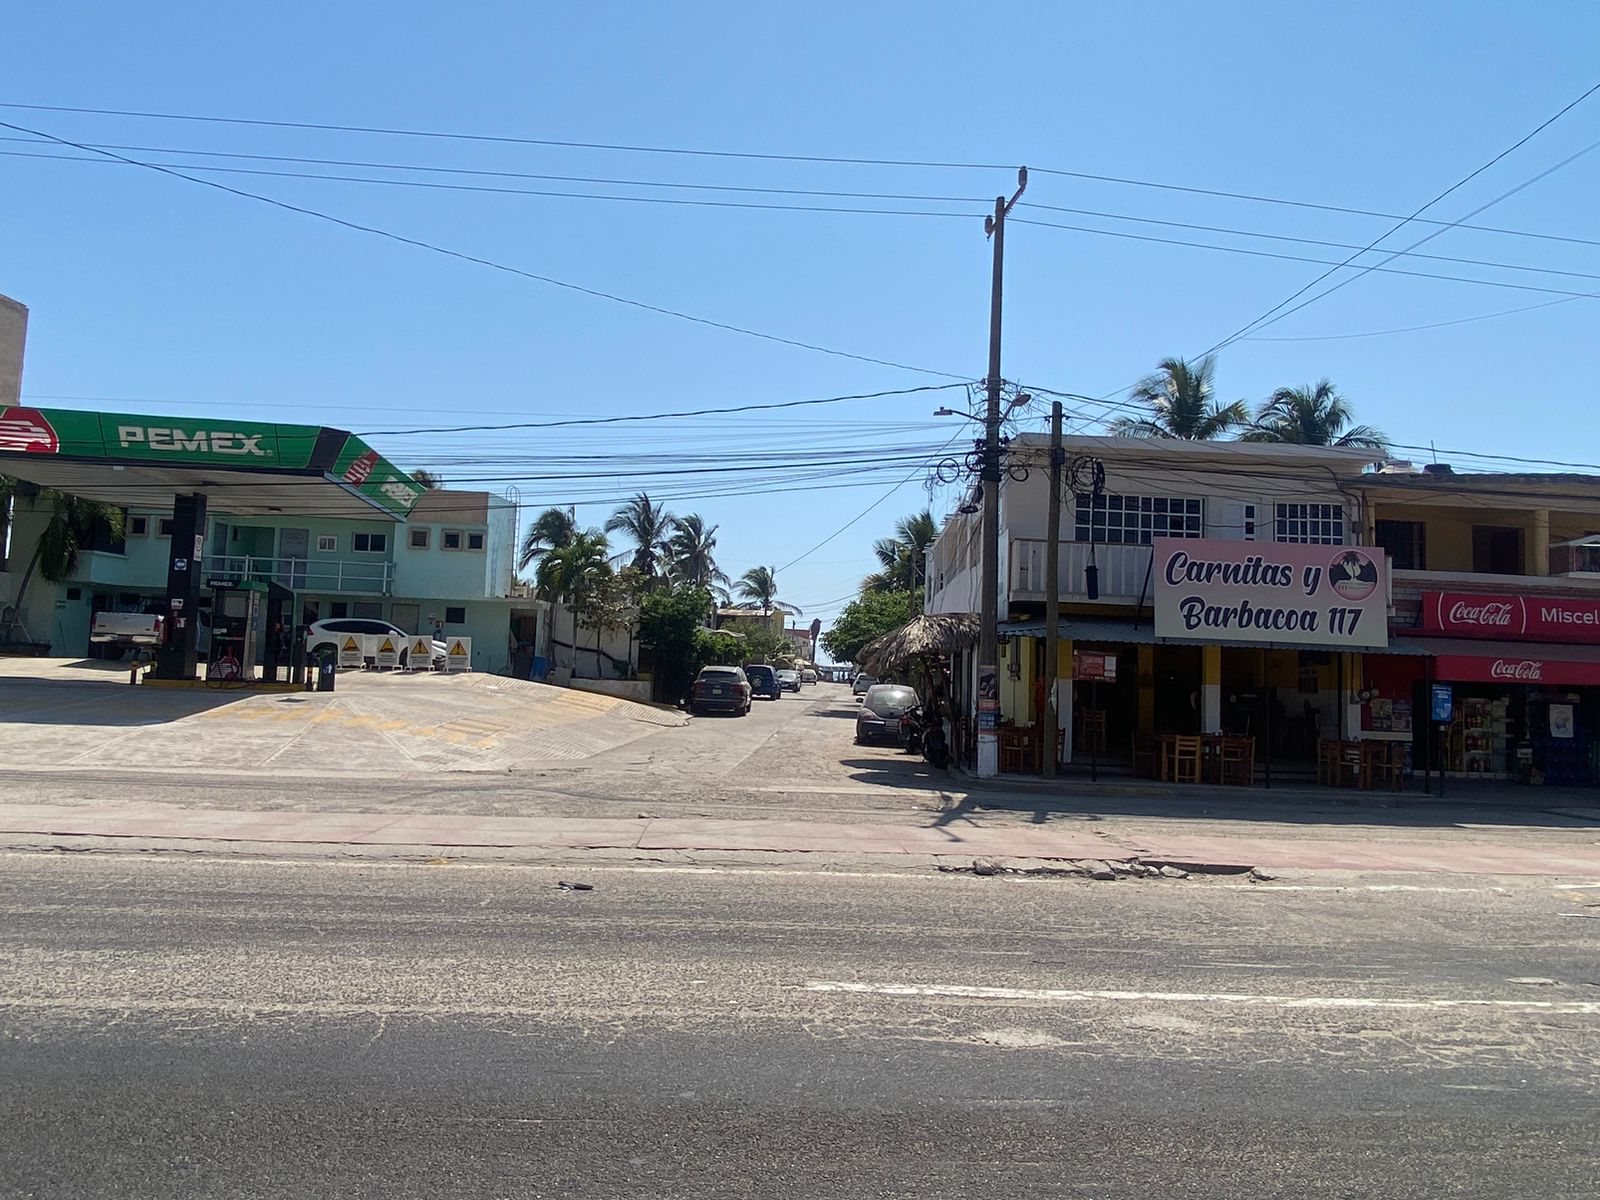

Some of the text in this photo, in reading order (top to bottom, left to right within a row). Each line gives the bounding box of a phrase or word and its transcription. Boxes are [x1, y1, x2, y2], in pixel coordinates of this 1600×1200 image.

[118, 425, 266, 457] PEMEX
[1164, 550, 1323, 597] Carnitas y
[1179, 595, 1364, 637] Barbacoa 117
[1449, 601, 1514, 626] Coca-Cola
[1490, 659, 1544, 680] Coca-Cola
